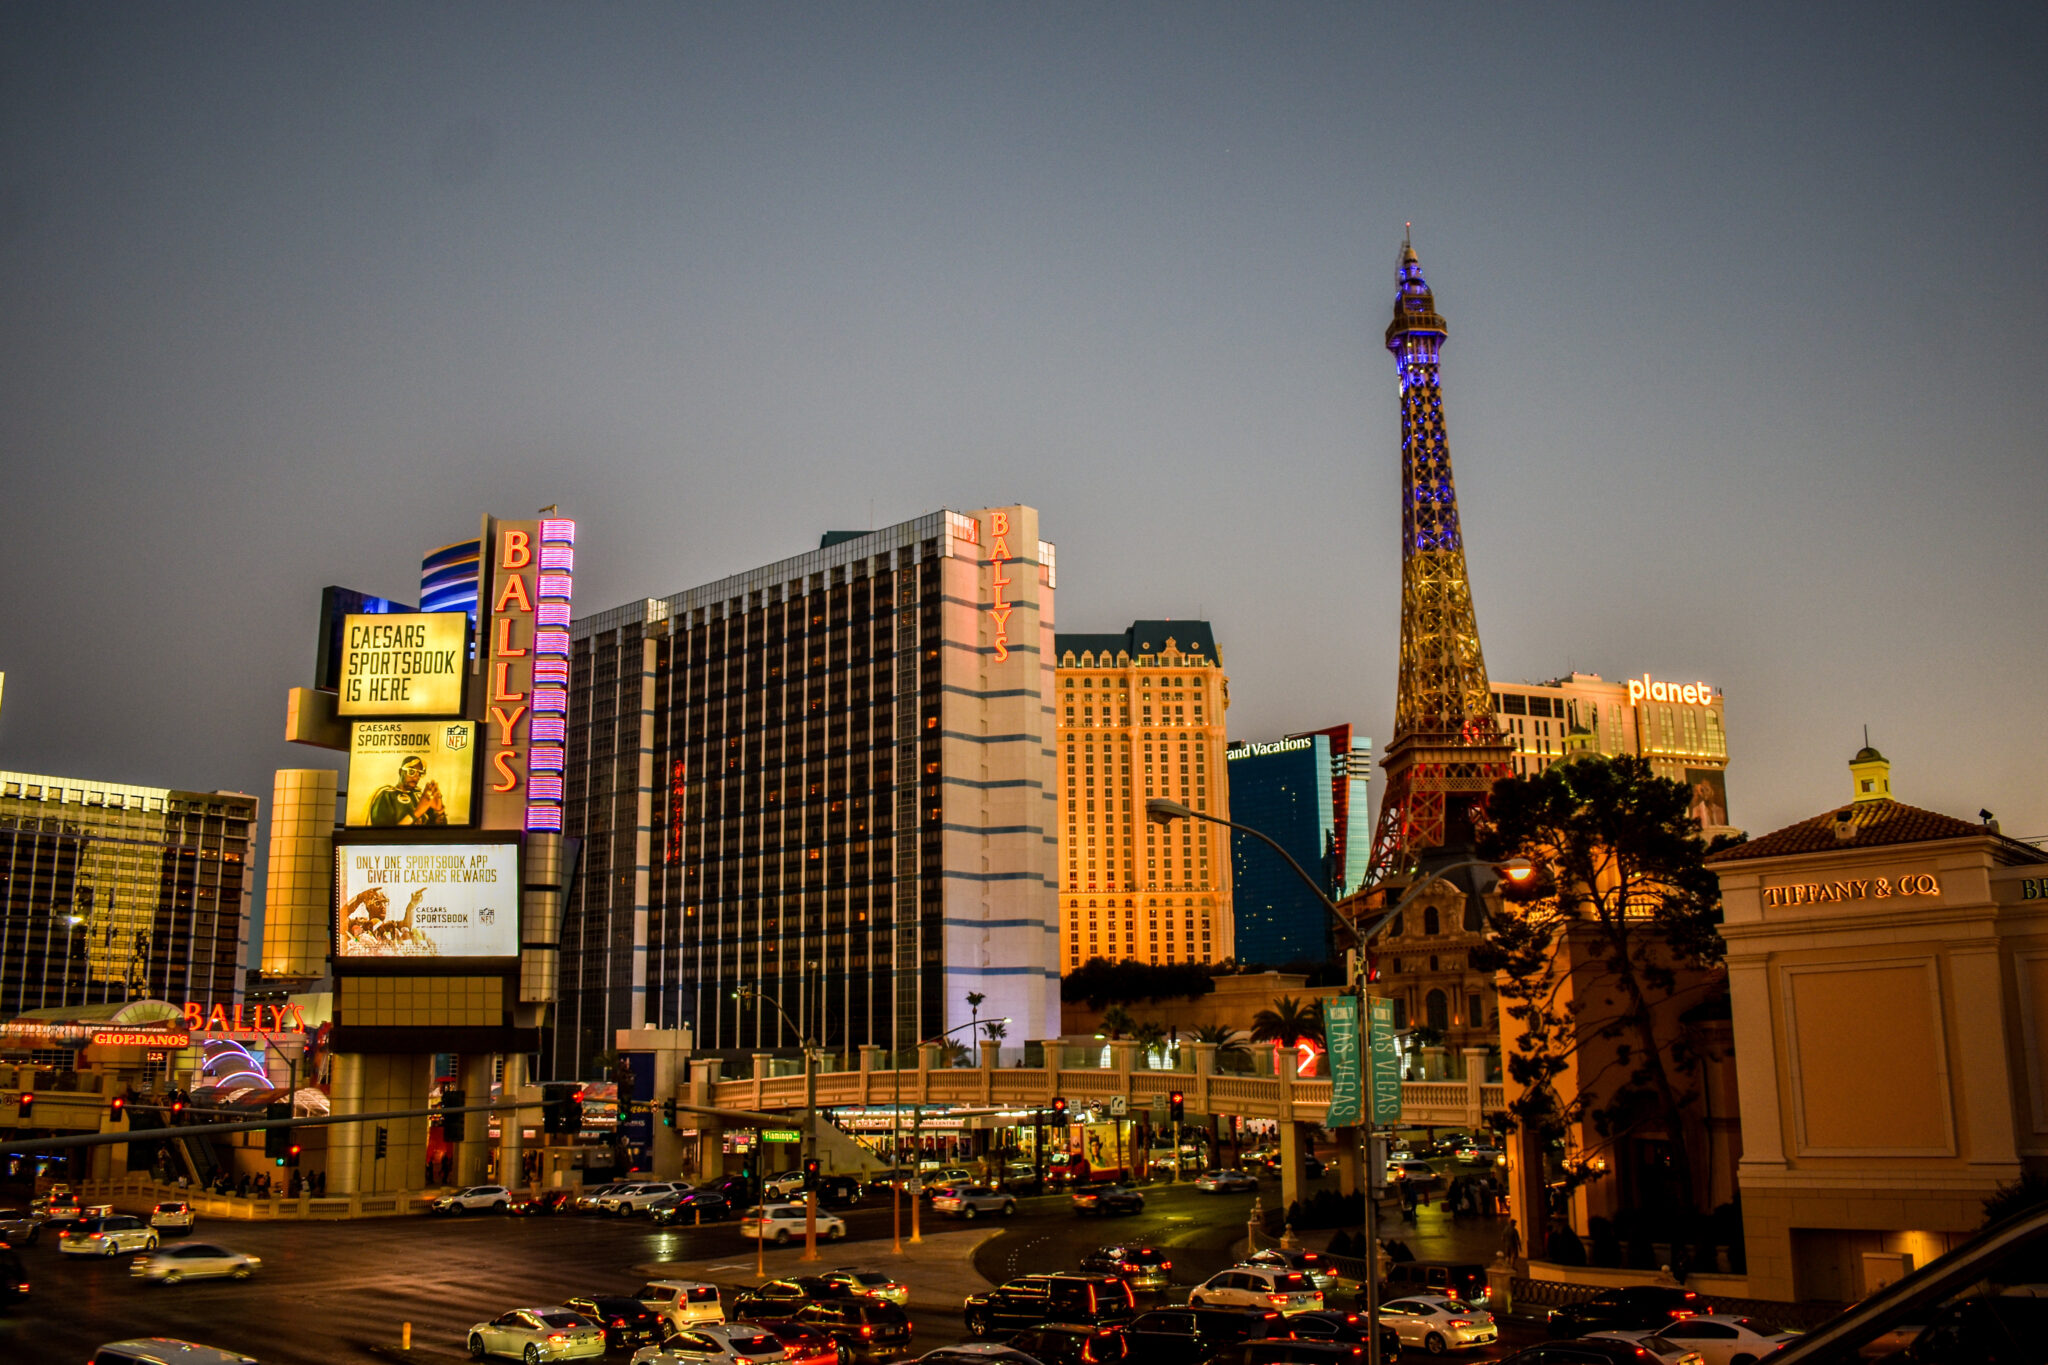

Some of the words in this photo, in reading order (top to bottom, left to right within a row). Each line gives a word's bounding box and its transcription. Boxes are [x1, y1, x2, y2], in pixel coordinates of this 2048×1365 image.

[990, 512, 1012, 662] BALLYS
[351, 625, 425, 649] CAESARS
[348, 650, 456, 675] SPORTSBOOK
[491, 530, 532, 792] BALLYS
[346, 678, 362, 702] IS
[369, 677, 411, 702] HERE
[1628, 673, 1712, 706] planet
[357, 733, 431, 746] SPORTSBOOK
[358, 724, 402, 732] CAESARS
[448, 735, 465, 748] NFL
[1251, 737, 1312, 756] Vacations
[356, 855, 381, 870] ONLY
[384, 855, 402, 870] ONE
[405, 855, 466, 869] SPORTSBOOK
[470, 855, 488, 869] APP
[367, 869, 400, 884] GIVETH
[403, 869, 447, 883] CAESARS
[450, 869, 497, 883] REWARDS
[1763, 879, 1868, 907] TIFFANY
[1874, 876, 1892, 898] &
[415, 914, 469, 923] SPORTSBOOK
[183, 1001, 305, 1035] BALLY'S
[93, 1032, 188, 1046] GIORDANO'S
[206, 1031, 235, 1040] LAS
[1331, 1022, 1354, 1054] LAS
[1373, 1023, 1394, 1053] LAS
[1331, 1060, 1356, 1116] VEGAS
[1375, 1060, 1398, 1114] VEGAS
[765, 1131, 793, 1142] Flamingo
